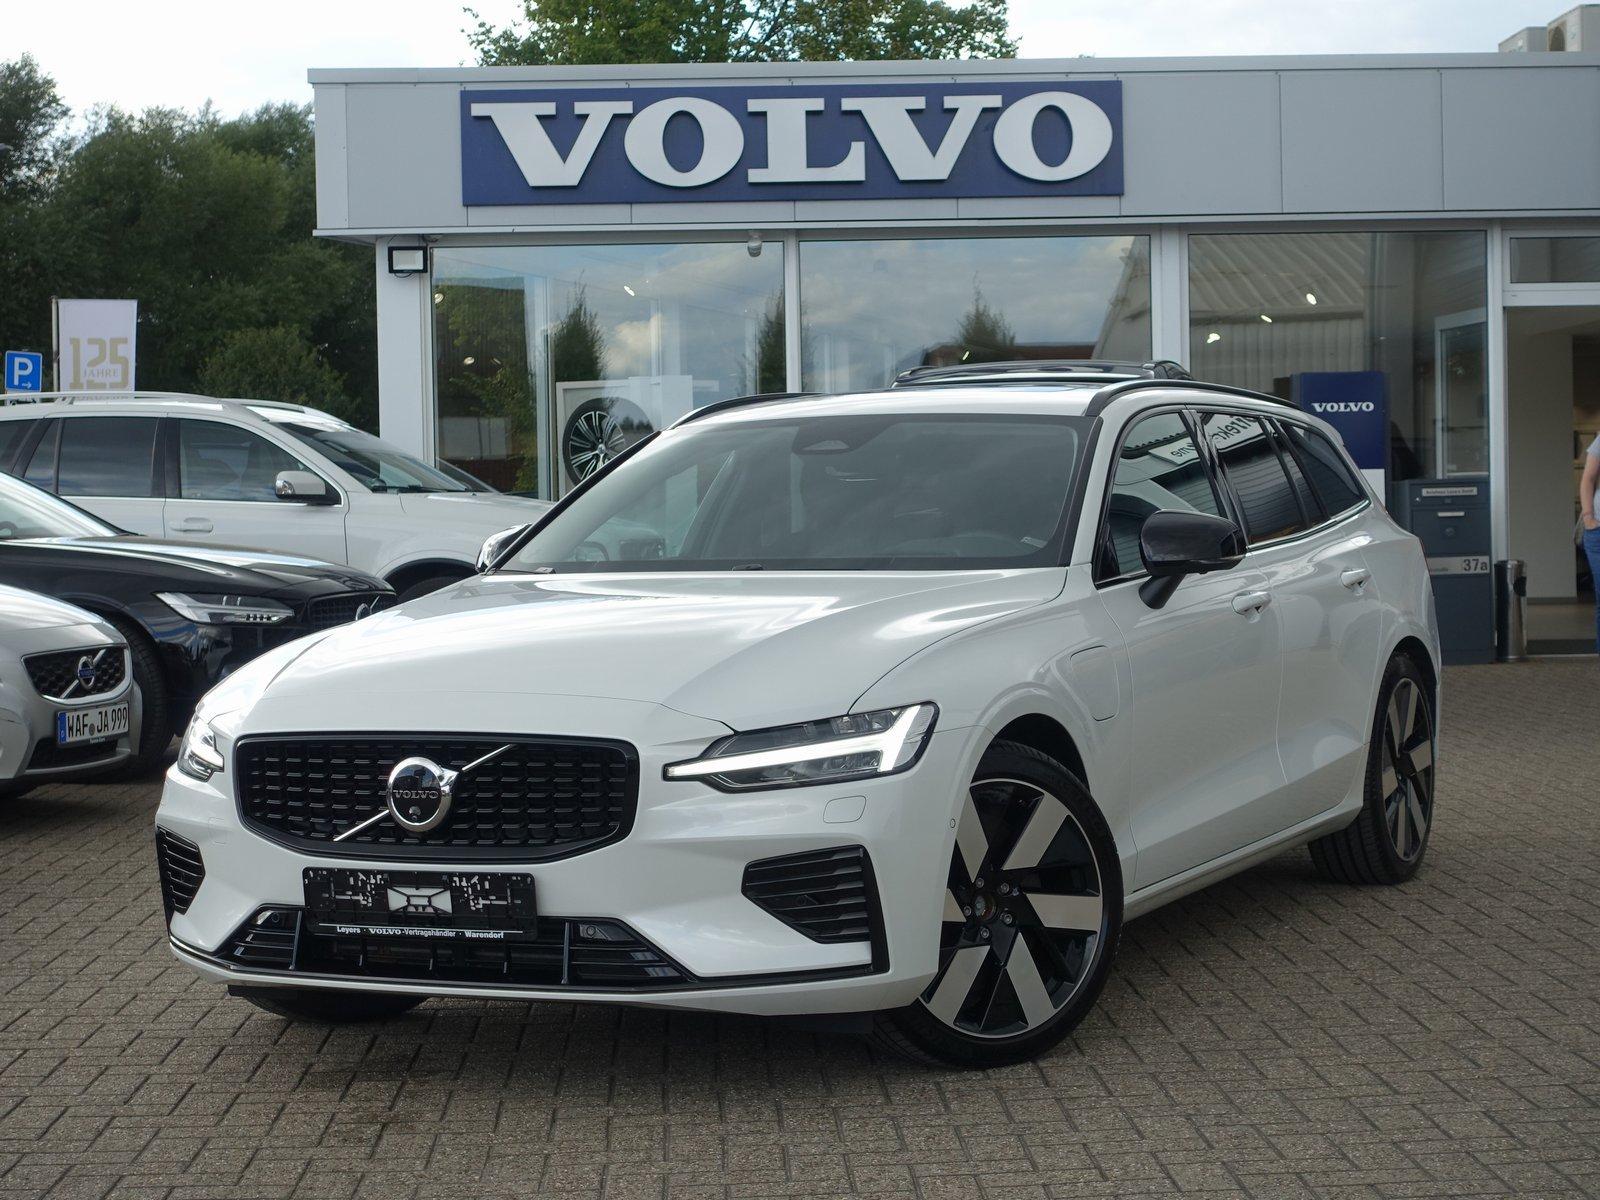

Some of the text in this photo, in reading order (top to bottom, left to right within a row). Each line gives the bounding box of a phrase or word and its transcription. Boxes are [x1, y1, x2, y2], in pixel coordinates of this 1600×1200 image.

[471, 91, 1113, 188] VOLVO
[69, 337, 130, 389] 125
[13, 356, 33, 386] P
[83, 367, 119, 378] JAHRE
[1311, 401, 1375, 413] VOLVO
[1463, 558, 1488, 572] 37a
[67, 713, 88, 738] WAF
[97, 710, 109, 733] JA
[111, 706, 128, 731] 999
[393, 789, 439, 799] VOLVO
[336, 926, 361, 934] Leyers
[465, 930, 504, 939] Warendorf
